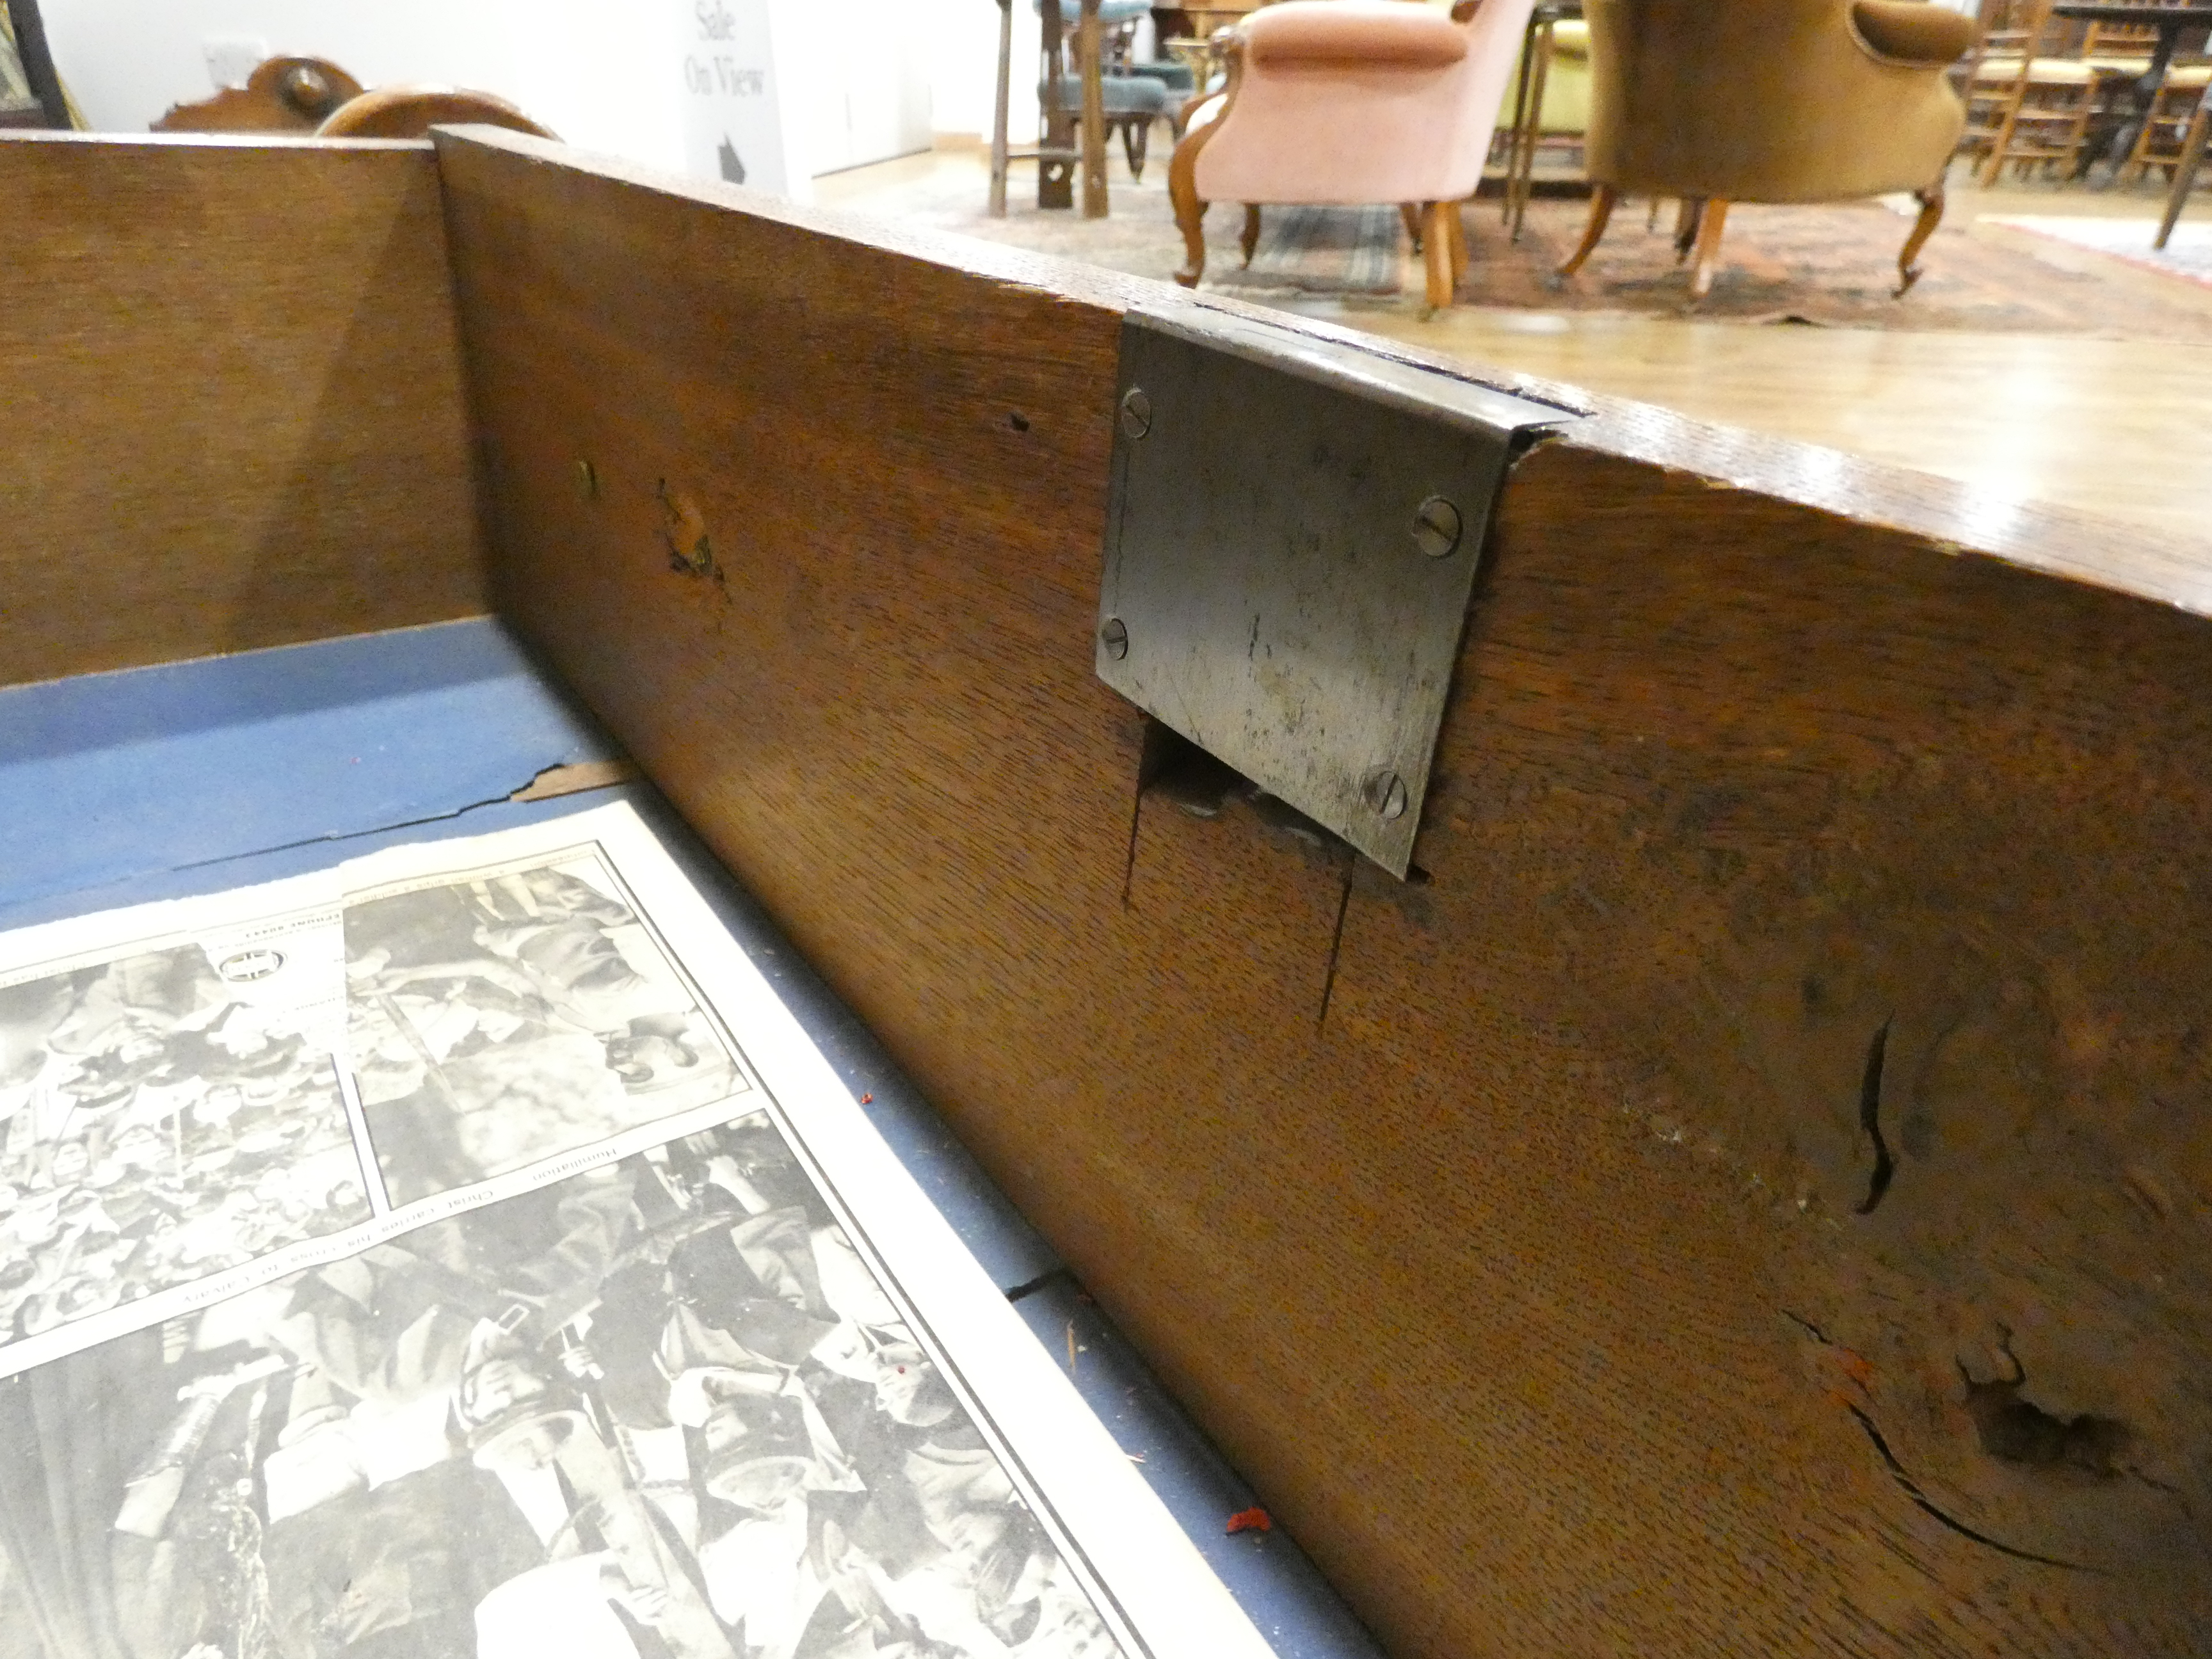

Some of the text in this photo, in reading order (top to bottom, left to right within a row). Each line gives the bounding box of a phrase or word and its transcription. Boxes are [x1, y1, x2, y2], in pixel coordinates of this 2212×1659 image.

[683, 54, 765, 97] On View
[533, 1148, 617, 1181] Humiliation
[448, 1190, 493, 1209] Christ
[381, 1208, 435, 1233] carries
[348, 1234, 371, 1247] his
[184, 1276, 250, 1302] Calvary
